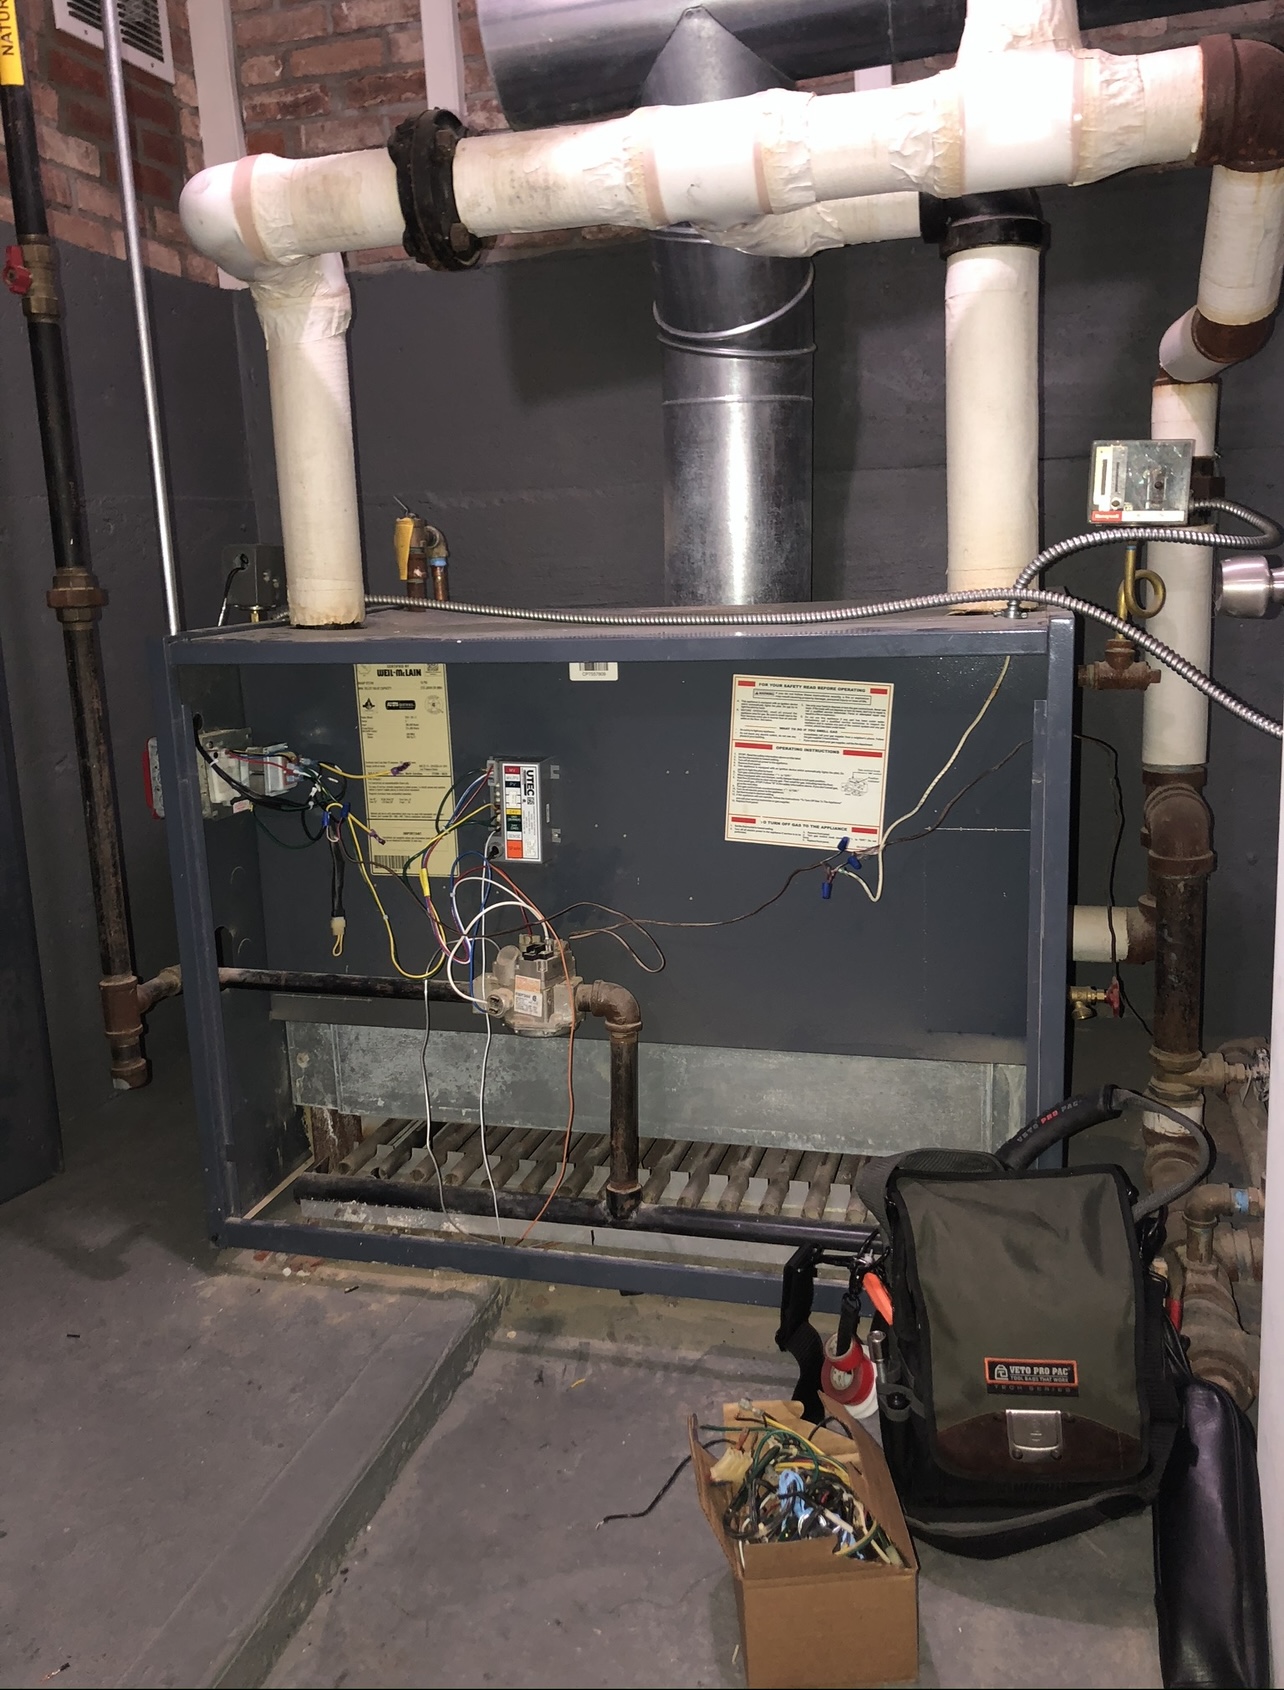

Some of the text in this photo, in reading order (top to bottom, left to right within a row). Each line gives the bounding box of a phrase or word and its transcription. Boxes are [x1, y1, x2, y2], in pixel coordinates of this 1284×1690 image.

[526, 770, 534, 796] UTEC
[1016, 1102, 1078, 1142] VETO PRO PAC
[1009, 1366, 1031, 1374] VETO
[1052, 1367, 1069, 1375] PAC
